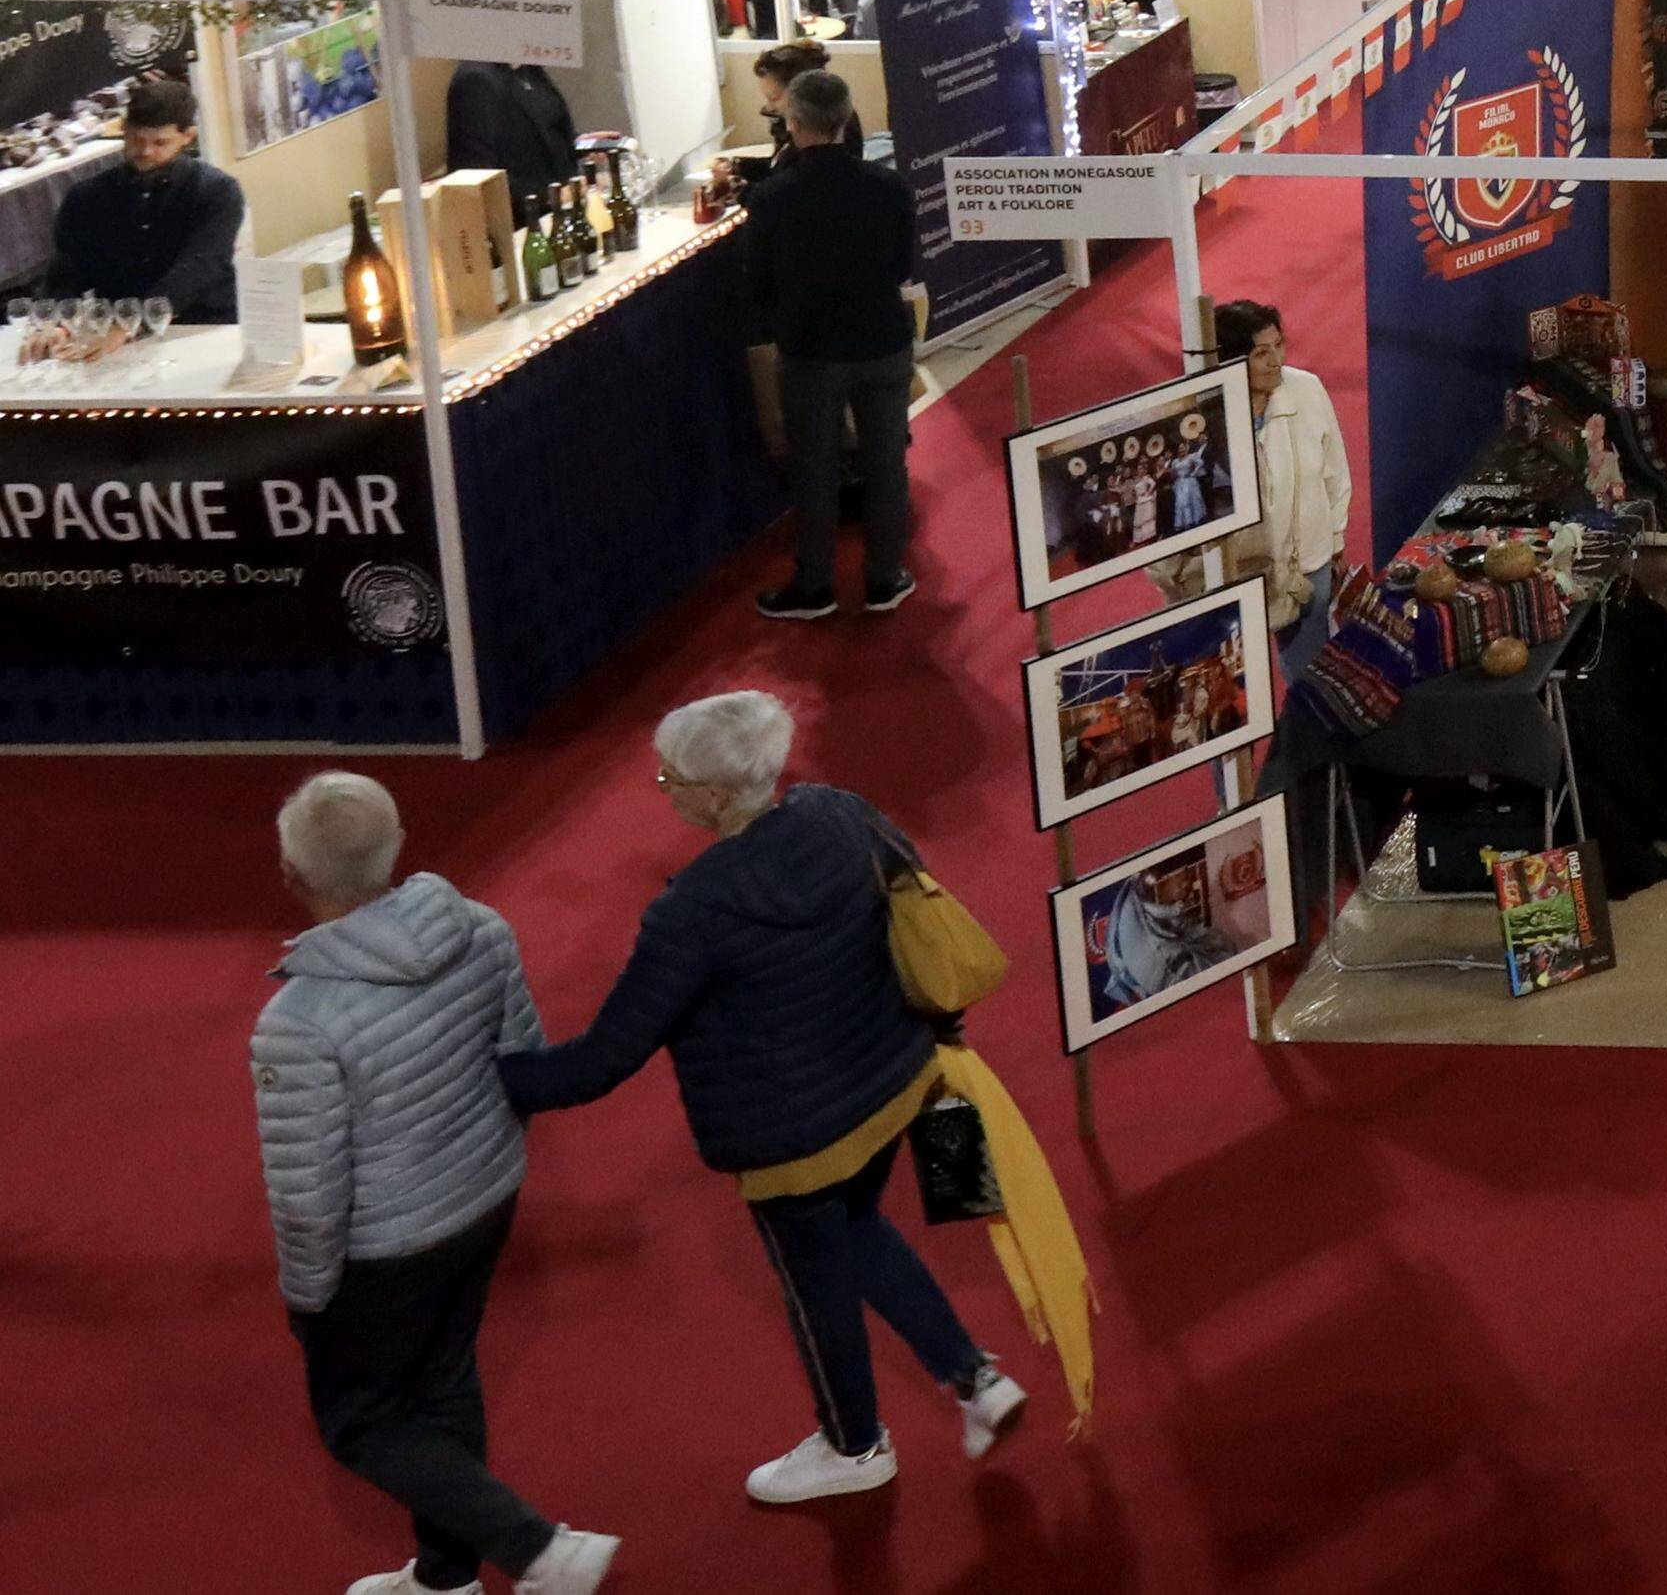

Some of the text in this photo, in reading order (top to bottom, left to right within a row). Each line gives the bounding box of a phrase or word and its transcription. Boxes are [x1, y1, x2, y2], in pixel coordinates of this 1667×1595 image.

[523, 1, 573, 16] DOURY
[1483, 102, 1511, 120] FILIAL
[1478, 110, 1516, 131] MONACO
[955, 167, 1155, 181] ASSOCIATION MONEGASQUE
[957, 183, 1083, 195] PEROU TRADITION
[958, 198, 1075, 211] ART & FOLKLORE
[959, 219, 985, 235] 93
[1455, 229, 1541, 271] CLUB LIBERTAD
[0, 474, 405, 541] PAGNE BAR
[130, 562, 227, 589] Philippe
[233, 562, 303, 588] Doury
